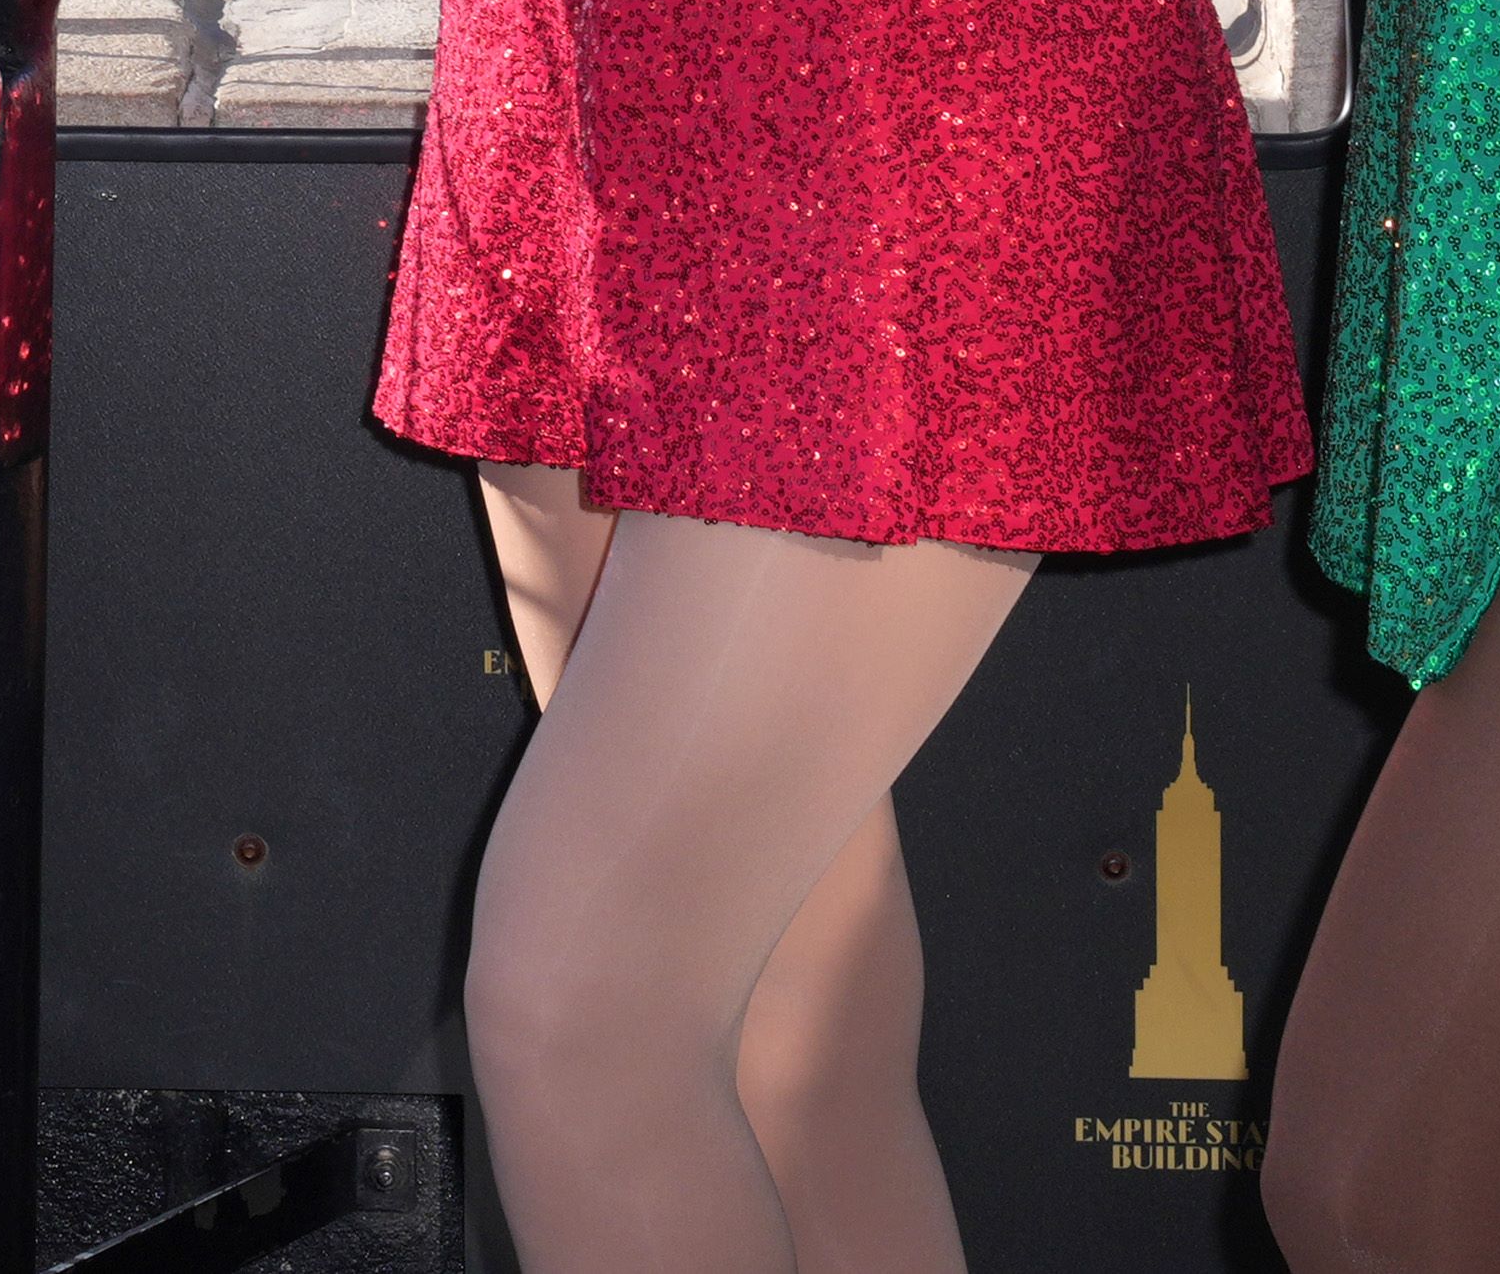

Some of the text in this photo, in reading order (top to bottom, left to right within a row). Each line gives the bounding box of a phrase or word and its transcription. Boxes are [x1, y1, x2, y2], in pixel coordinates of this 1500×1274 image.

[1169, 1102, 1210, 1118] THE
[1075, 1117, 1270, 1145] EMPIRE STA
